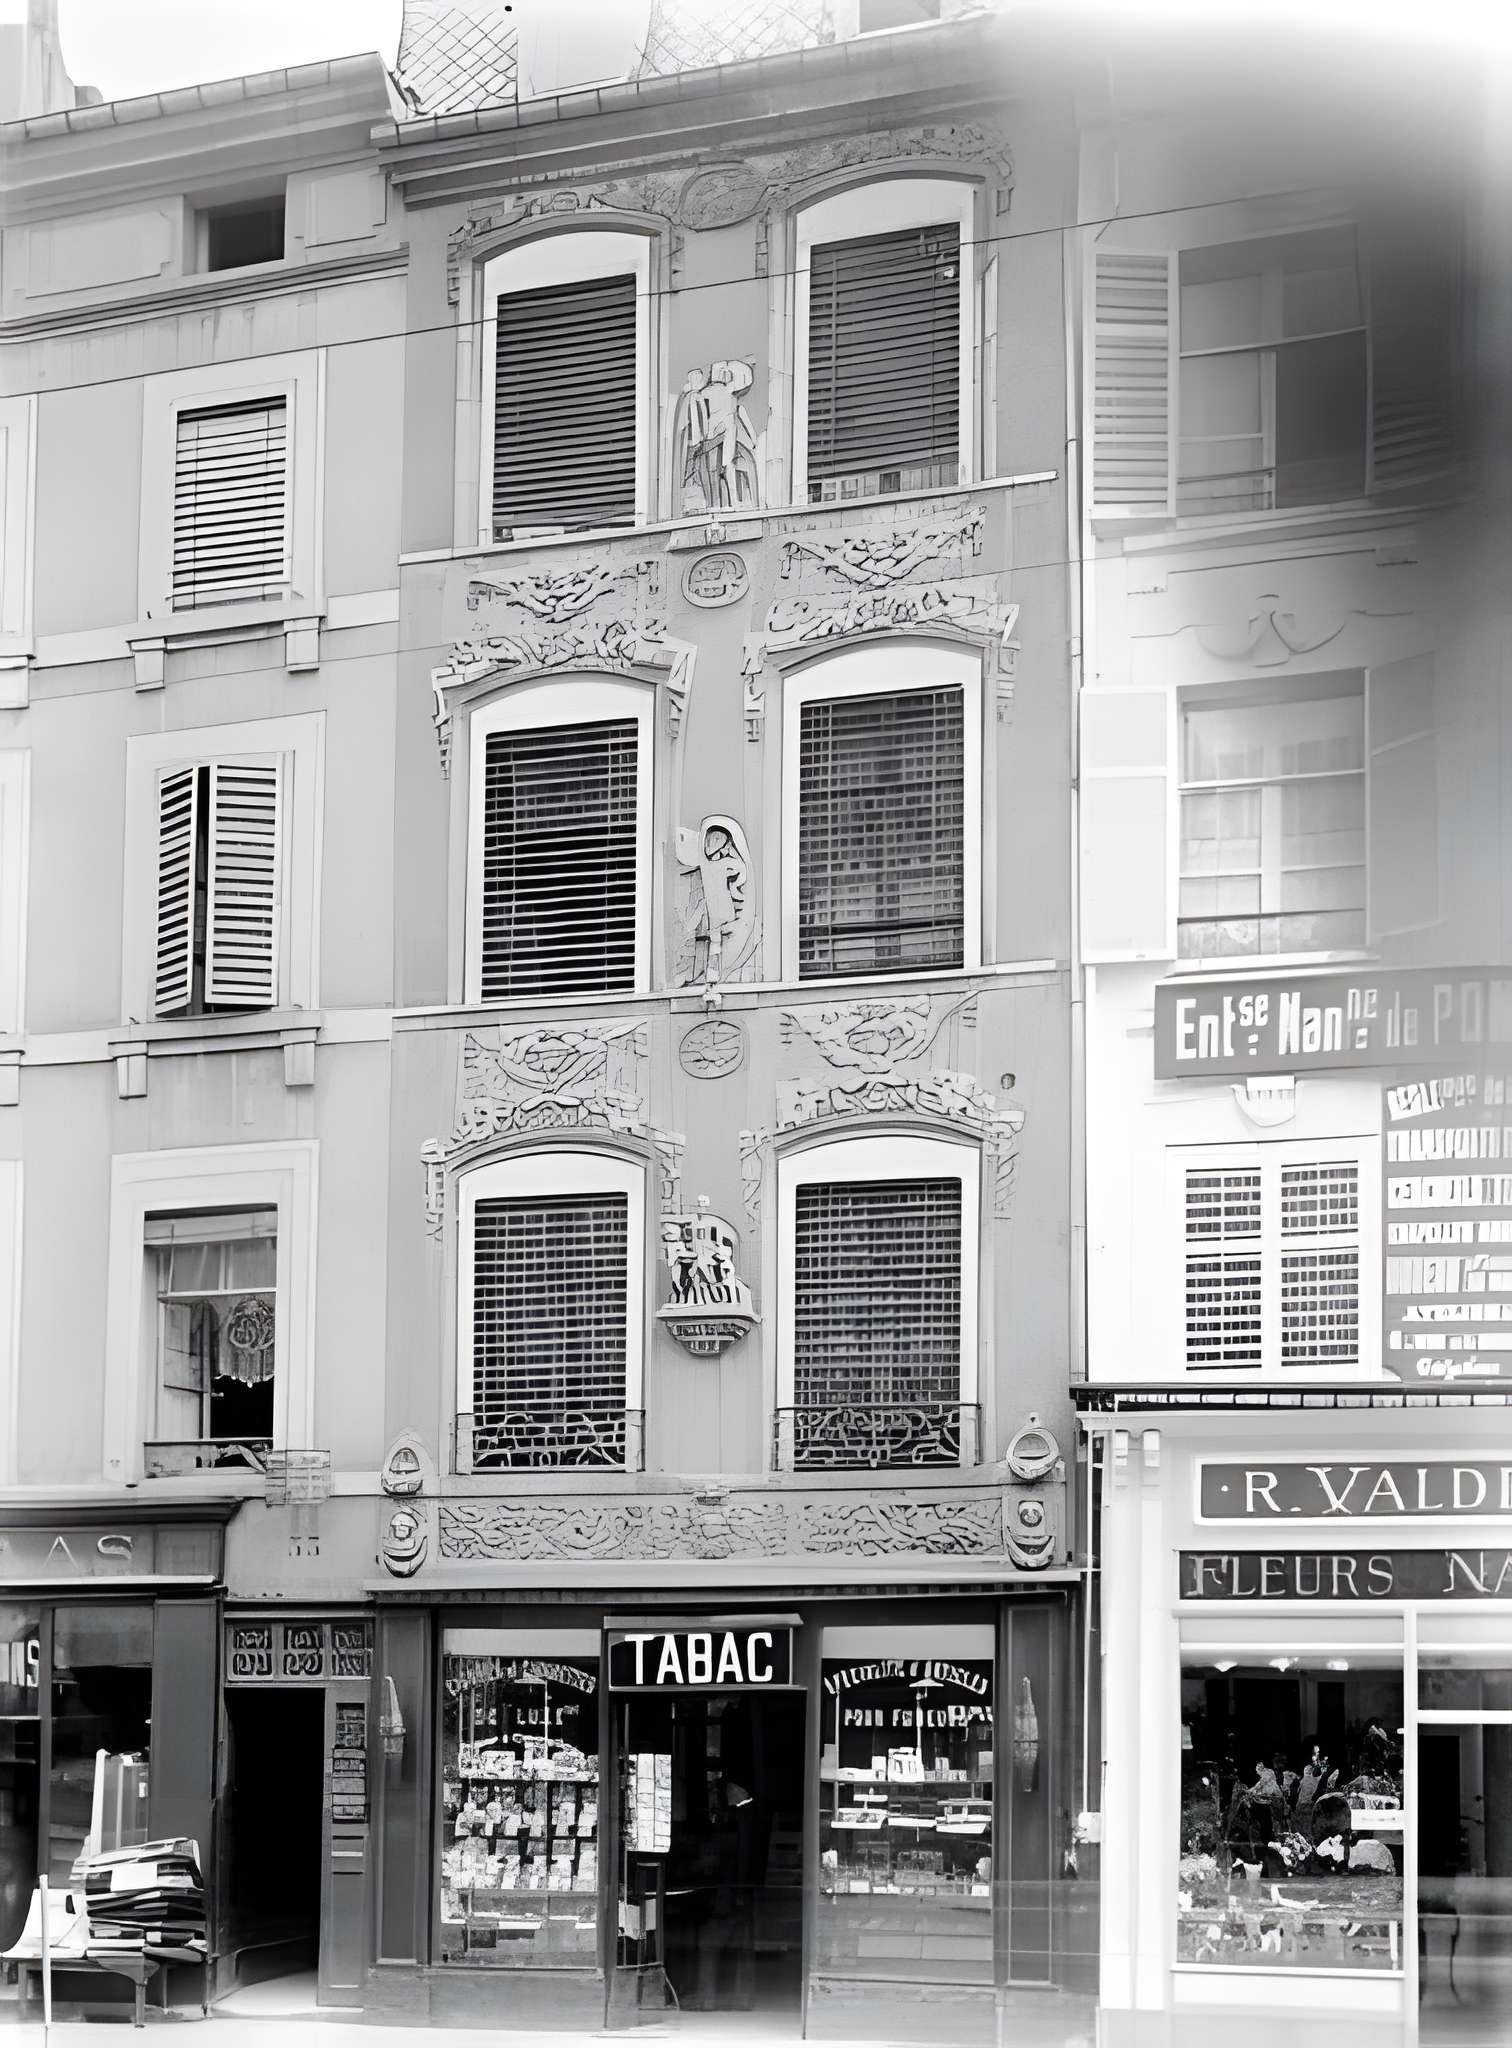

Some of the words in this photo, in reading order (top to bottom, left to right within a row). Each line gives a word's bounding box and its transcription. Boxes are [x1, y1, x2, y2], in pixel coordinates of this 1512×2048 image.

[1245, 1471, 1302, 1512] R.
[1186, 1556, 1394, 1596] FLEURS
[624, 1632, 773, 1684] TABAC
